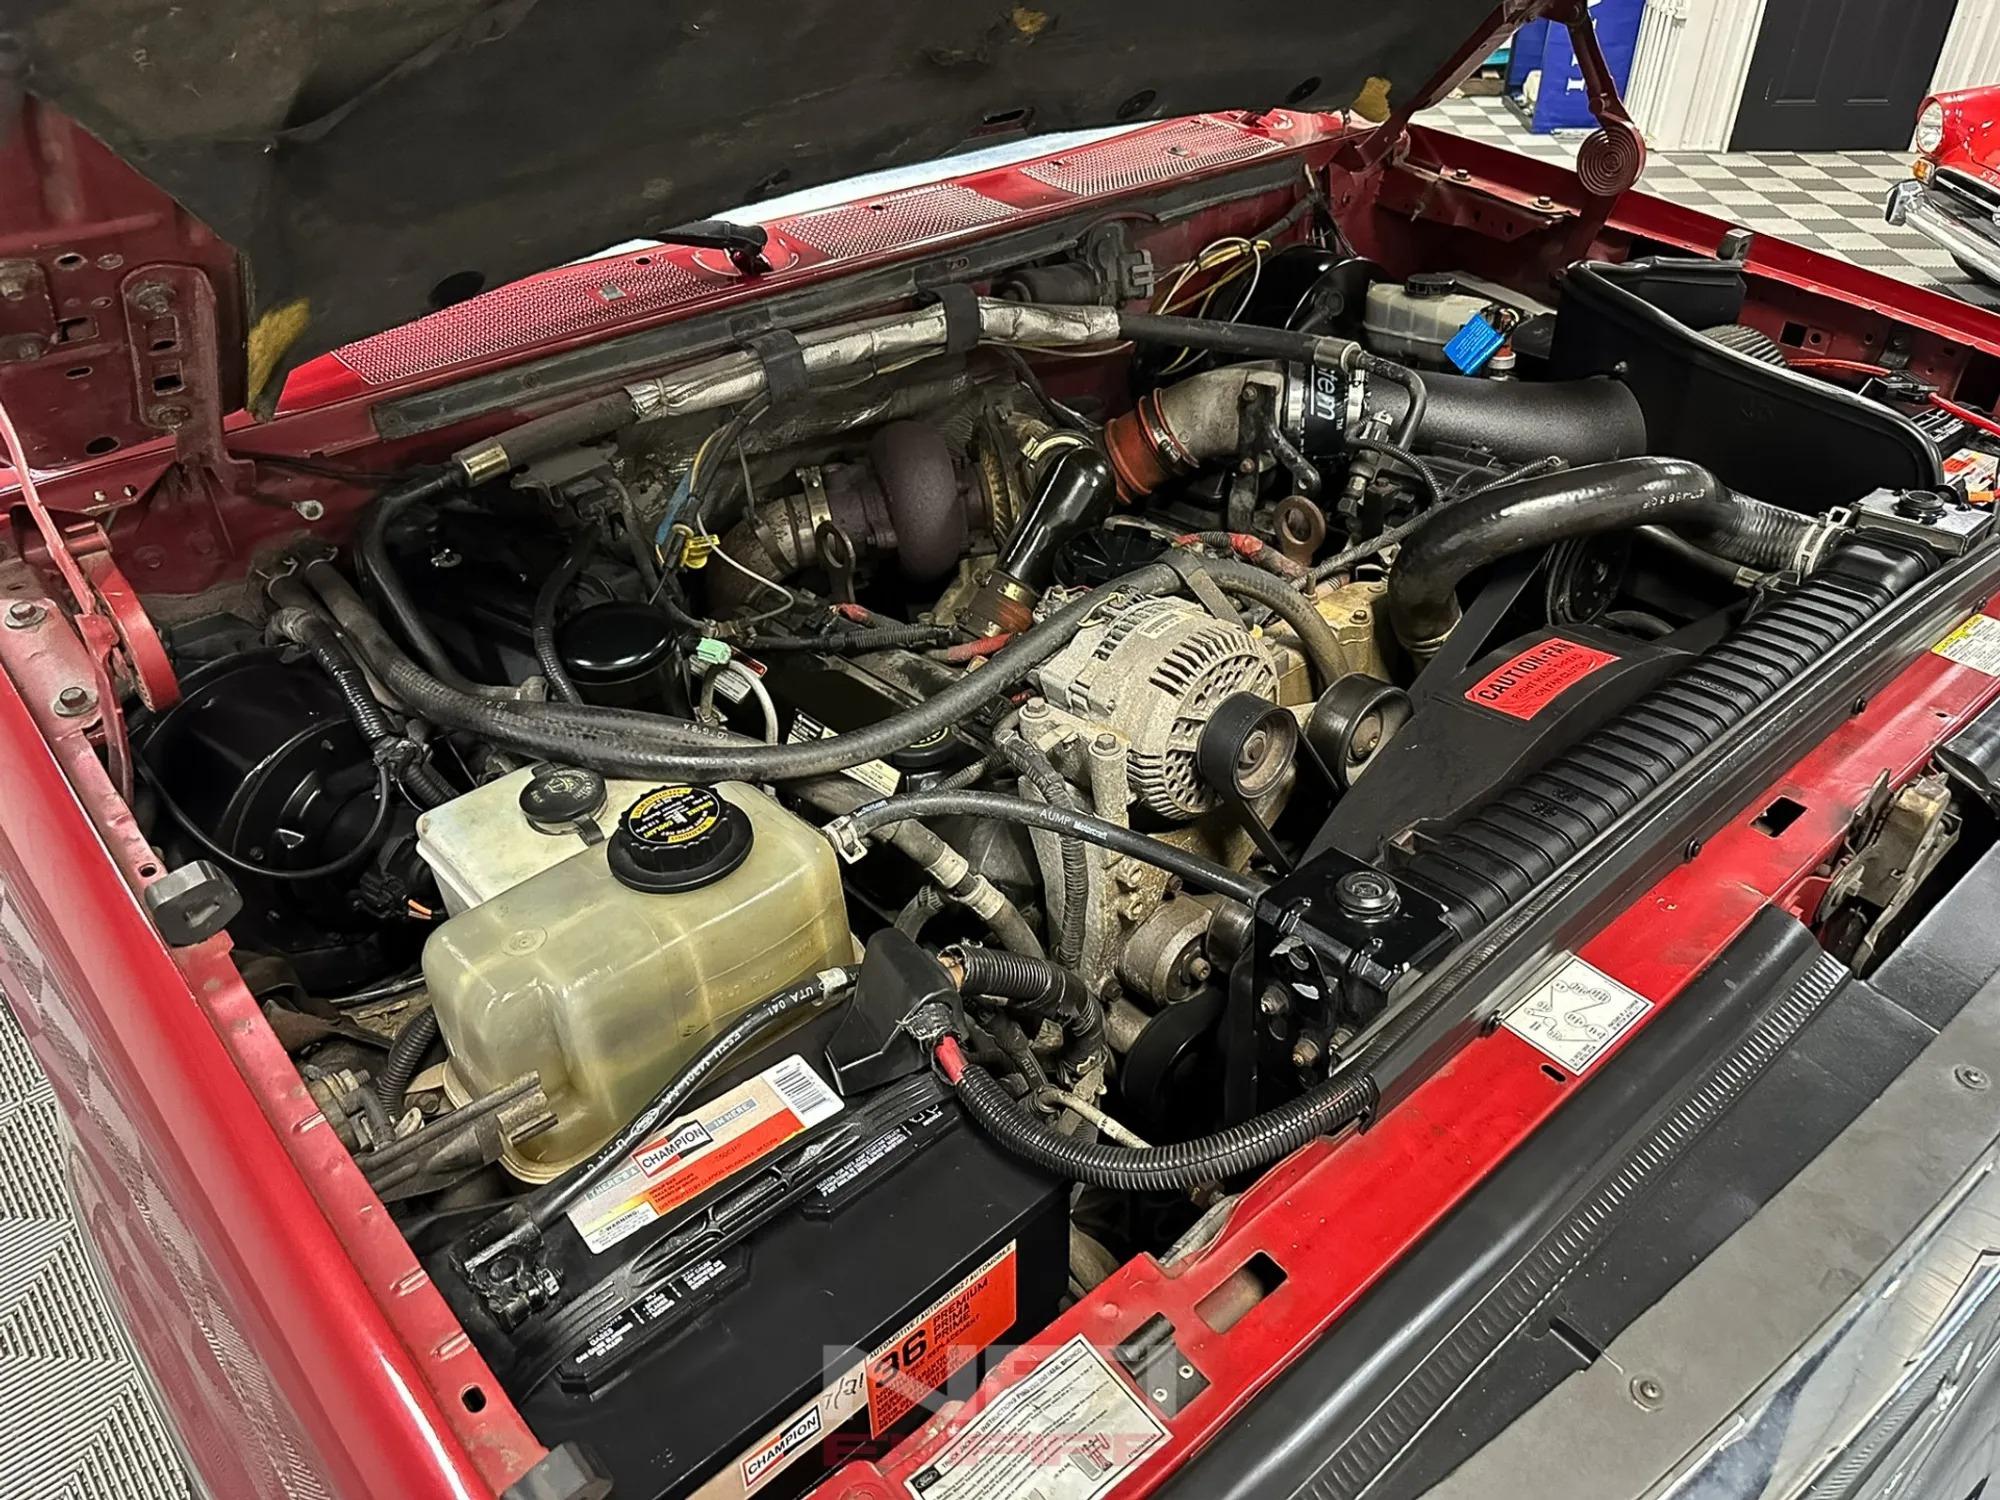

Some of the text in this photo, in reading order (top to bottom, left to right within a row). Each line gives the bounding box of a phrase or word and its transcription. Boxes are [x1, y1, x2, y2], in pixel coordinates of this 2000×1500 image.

[1512, 679, 1536, 699] RIGHT
[686, 800, 714, 816] ENGINE
[1040, 809, 1071, 825] AUMP
[644, 821, 673, 838] COOLANT
[767, 987, 815, 1016] UTA 041
[642, 1128, 704, 1169] CHAMPION
[933, 1277, 989, 1326] PREMIUM
[869, 1321, 916, 1360] AUTOMOTIVE
[874, 1303, 970, 1388] 36 PRIMA
[935, 1311, 971, 1344] PRIME
[916, 1473, 936, 1489] Ford
[941, 1452, 960, 1468] TRUCK
[980, 1396, 1017, 1435] INSTRUCTIONS
[1060, 1348, 1082, 1366] BRONCO
[748, 1415, 817, 1475] CHAMPION
